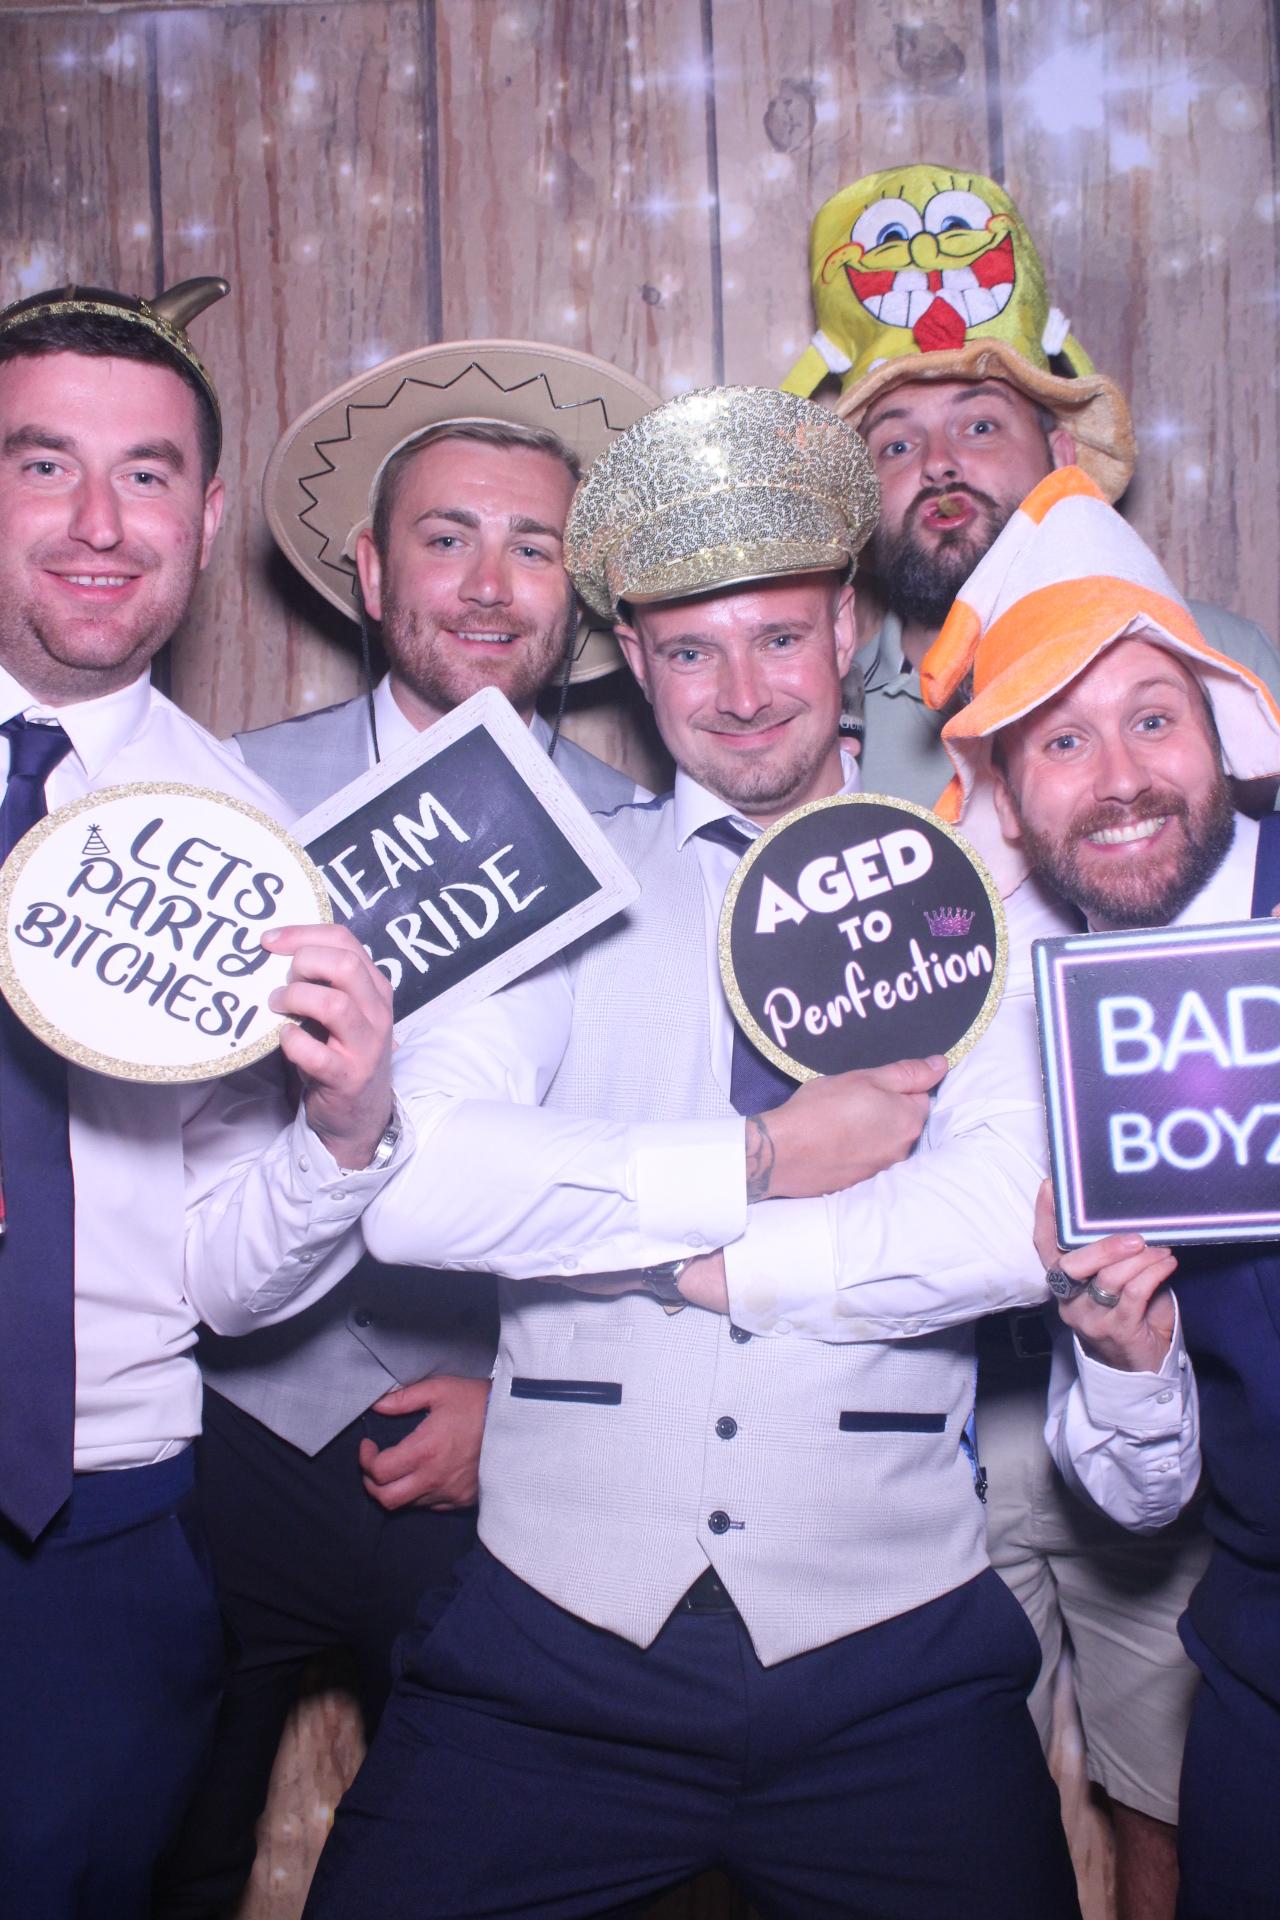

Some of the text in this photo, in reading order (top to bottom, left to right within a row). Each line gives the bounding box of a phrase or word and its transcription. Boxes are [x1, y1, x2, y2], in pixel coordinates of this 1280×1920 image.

[66, 856, 272, 977] PARTY
[130, 817, 284, 920] LETS
[754, 828, 934, 934] AGED
[14, 901, 259, 1048] BITCHES!
[837, 909, 893, 952] TO
[762, 937, 994, 1049] Perfection
[1097, 983, 1280, 1077] BAD
